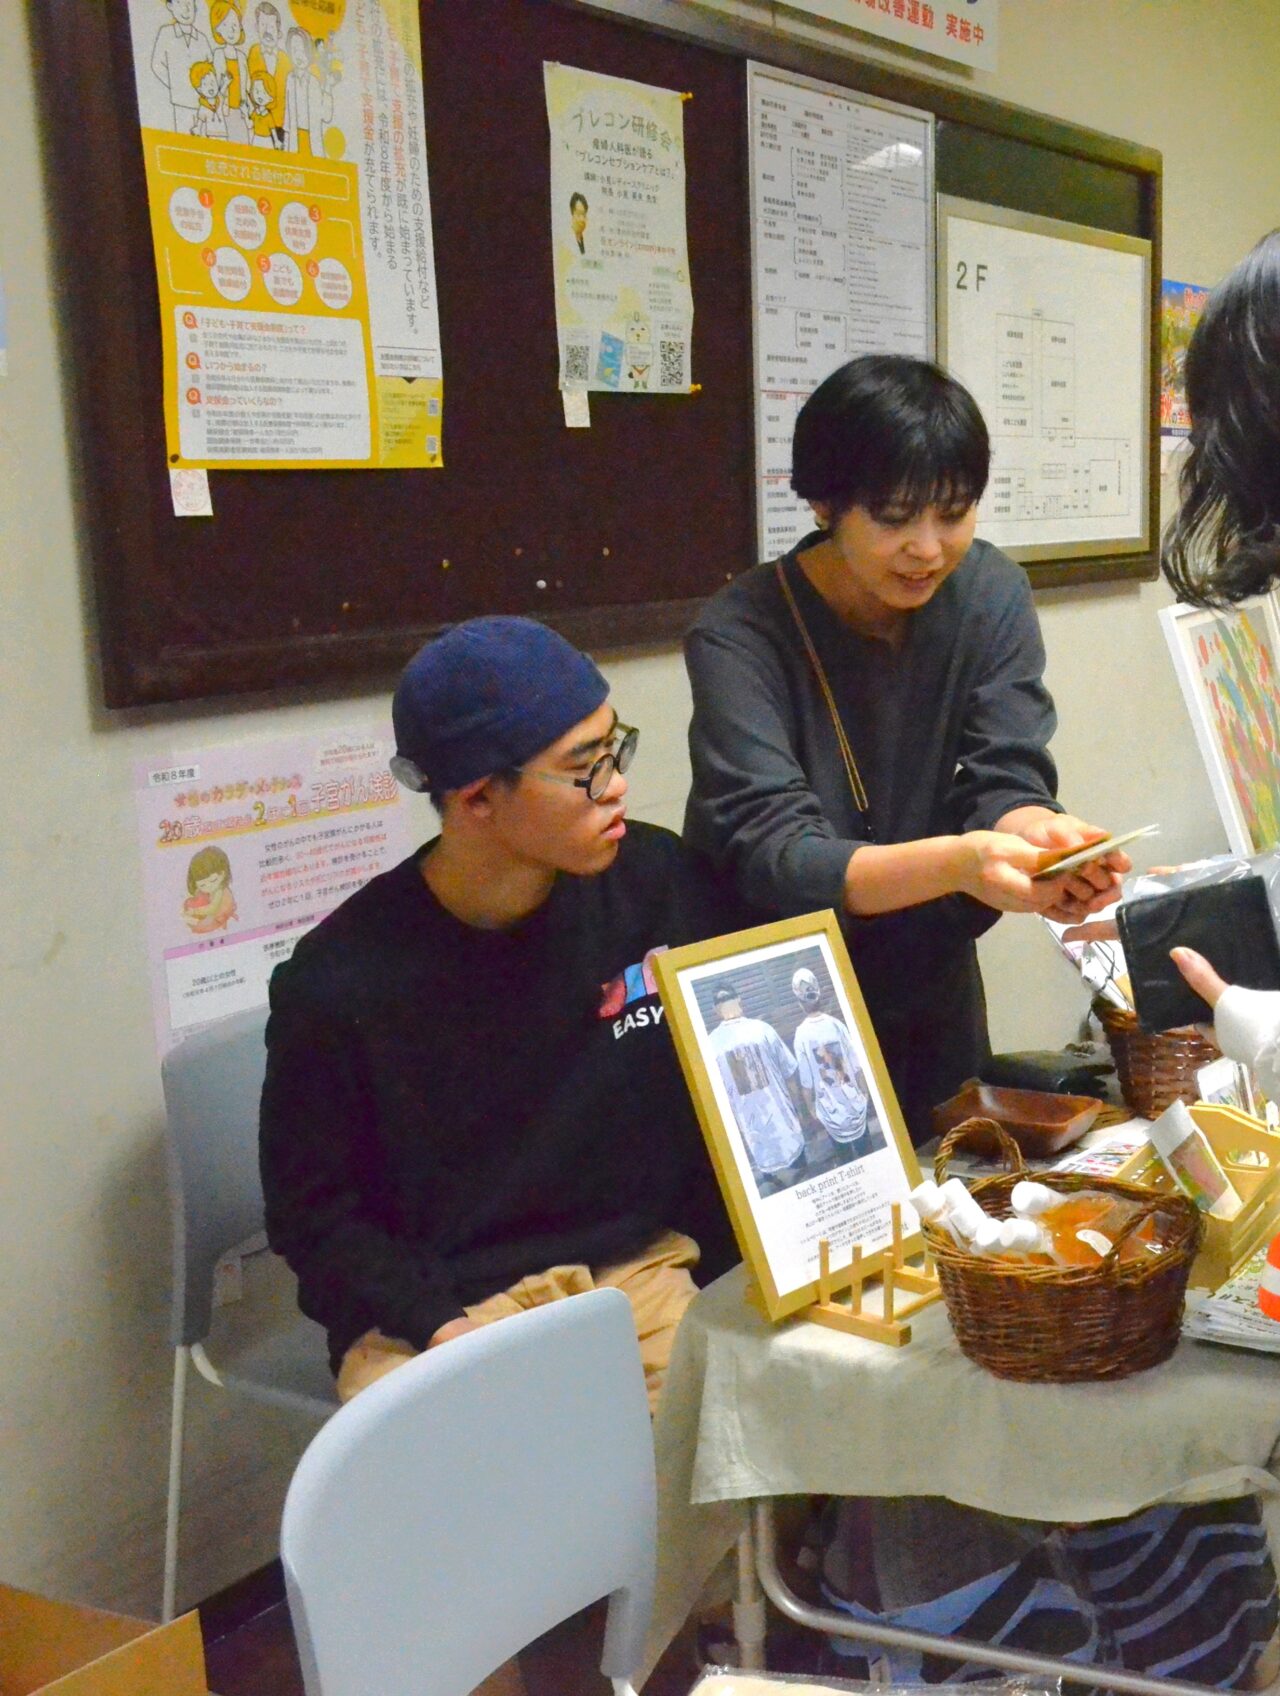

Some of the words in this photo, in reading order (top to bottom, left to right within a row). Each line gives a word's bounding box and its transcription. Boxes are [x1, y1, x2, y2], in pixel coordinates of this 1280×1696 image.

[946, 13, 984, 46] 実施中
[152, 768, 195, 783] 令和8年度
[612, 1005, 664, 1040] EASY
[795, 1184, 817, 1200] back
[817, 1175, 838, 1193] print
[838, 1164, 865, 1181] T-shirt
